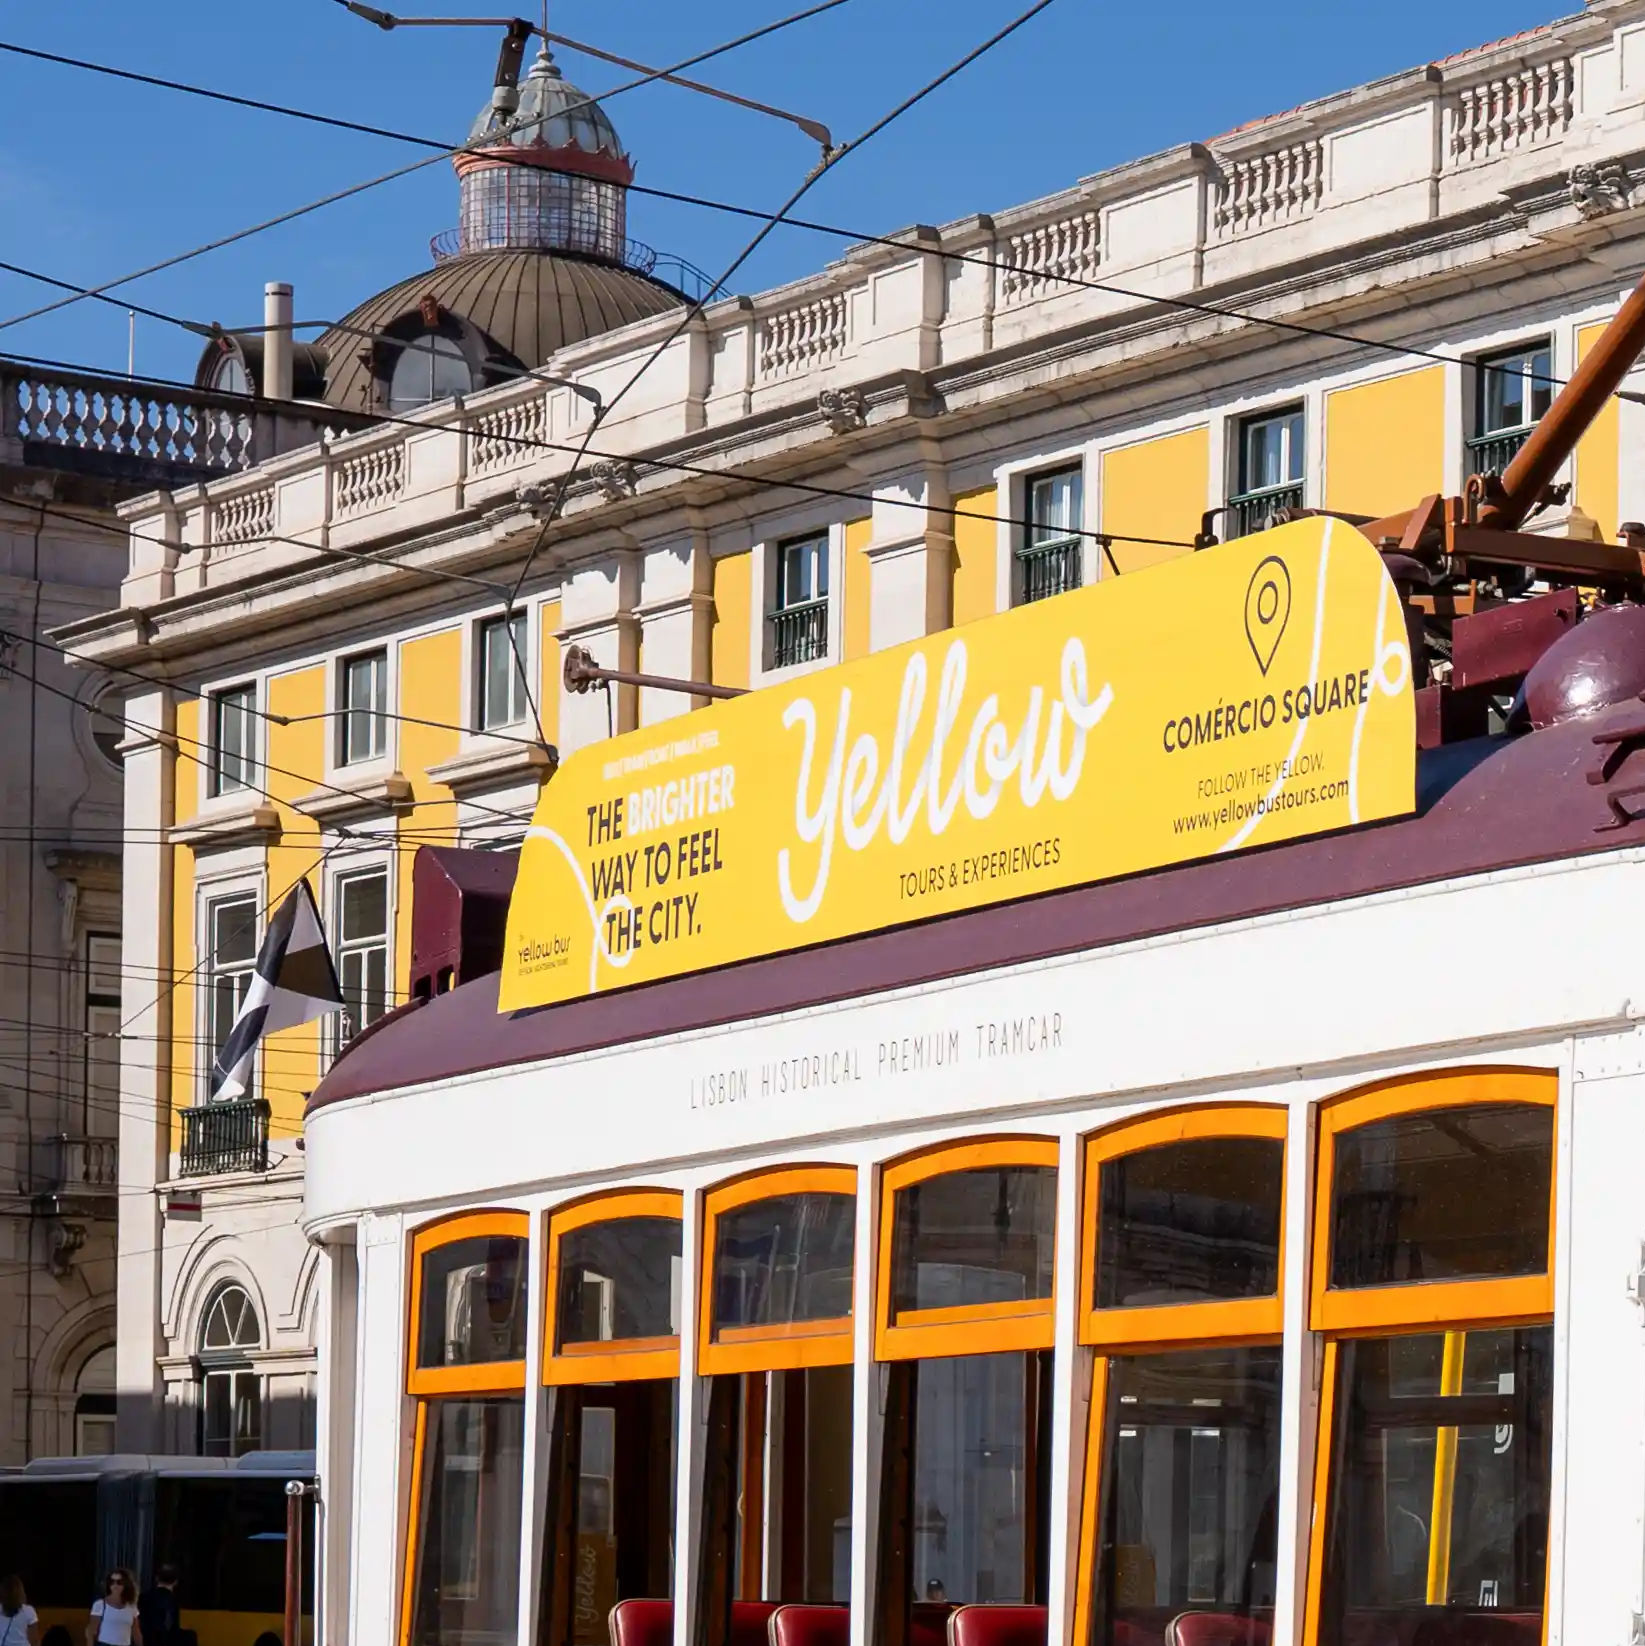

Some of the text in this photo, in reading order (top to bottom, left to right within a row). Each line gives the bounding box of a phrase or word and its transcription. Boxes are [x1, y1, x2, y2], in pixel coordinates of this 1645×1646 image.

[1163, 669, 1369, 753] COMÉRCIO SQUARE
[587, 764, 735, 847] THE BRIGHTER
[1173, 778, 1349, 835] www.yellowbustours.com
[1198, 752, 1325, 799] FOLLOW THE YELLOW.
[592, 828, 723, 901] WAY TO FEEL
[899, 838, 1062, 899] TOURS & EXPERIENCES
[606, 892, 702, 954] THE CITY.
[690, 1012, 1063, 1109] LISBON HISTORICAL PREMIUM TRAMCAR
